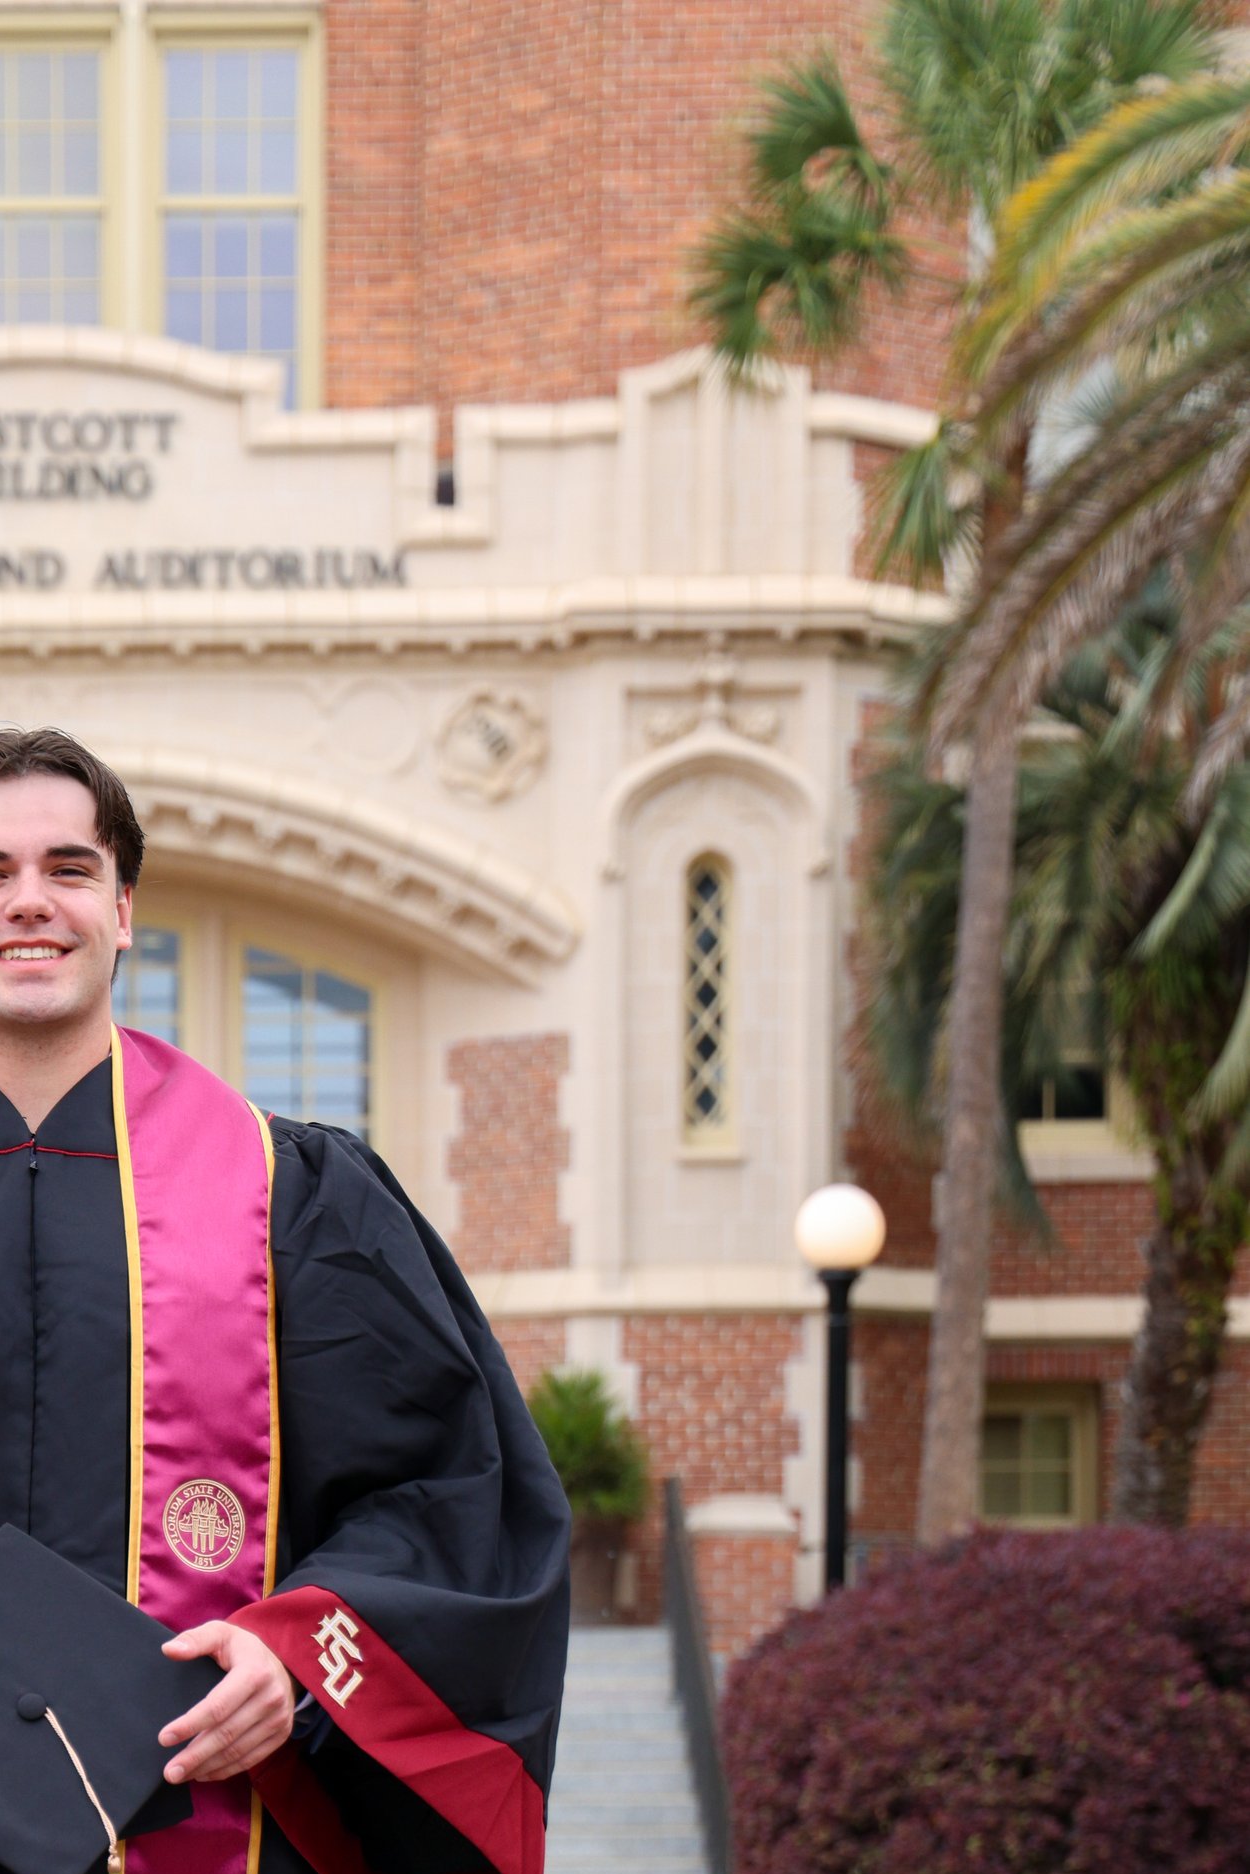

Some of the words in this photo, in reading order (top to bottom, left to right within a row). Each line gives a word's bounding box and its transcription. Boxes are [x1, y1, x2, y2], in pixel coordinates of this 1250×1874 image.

[95, 549, 409, 591] AUDITORIUM
[167, 1496, 184, 1547] FLORIDA
[182, 1484, 215, 1499] STATE
[215, 1489, 242, 1555] UNIVERSITY
[193, 1555, 215, 1567] 1851
[309, 1607, 364, 1709] FSU
